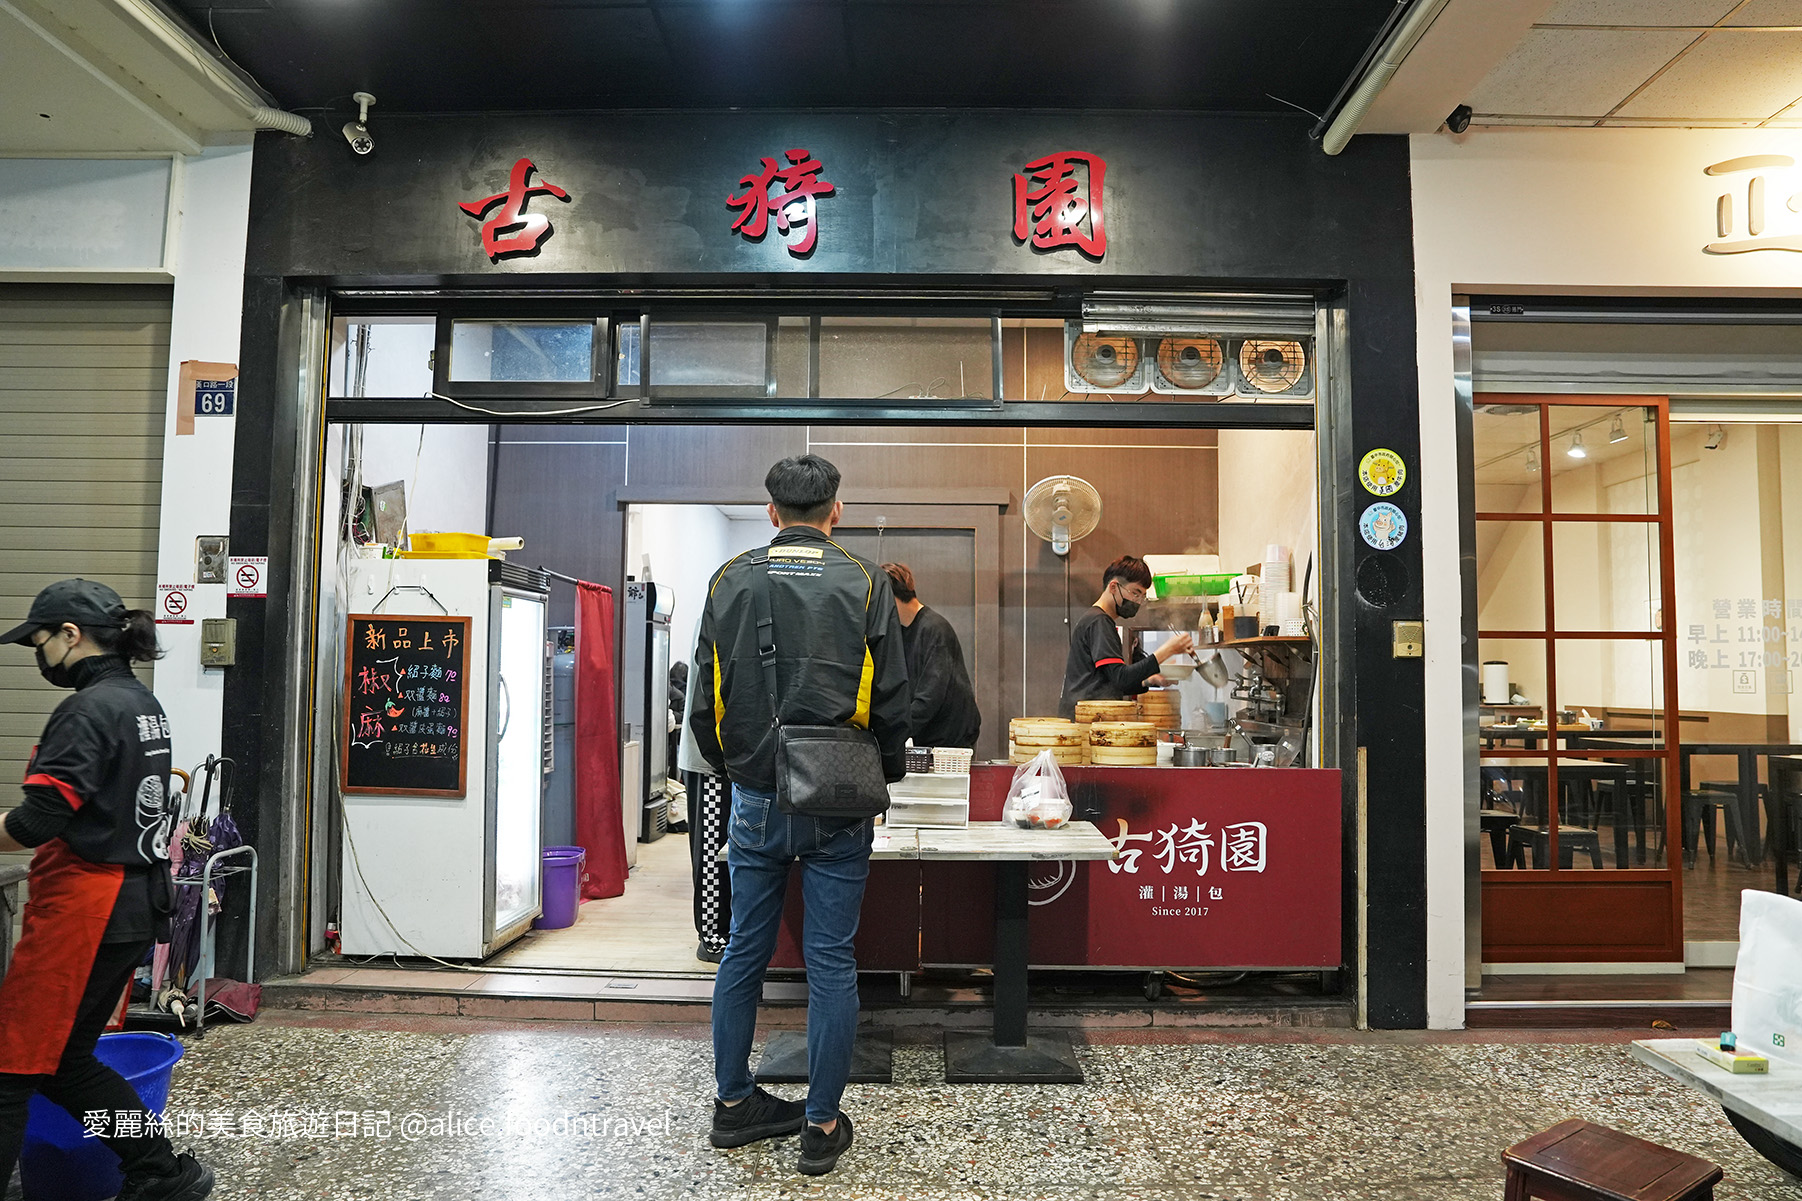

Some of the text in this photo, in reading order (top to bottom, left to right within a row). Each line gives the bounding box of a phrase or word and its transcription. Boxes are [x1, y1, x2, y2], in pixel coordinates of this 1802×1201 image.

[458, 149, 1107, 261] 古猗園
[201, 393, 226, 413] 69
[364, 623, 460, 659] 新品上市
[1687, 624, 1730, 645] 早上
[1688, 649, 1731, 670] 晚上
[1152, 906, 1209, 916] Since 2017
